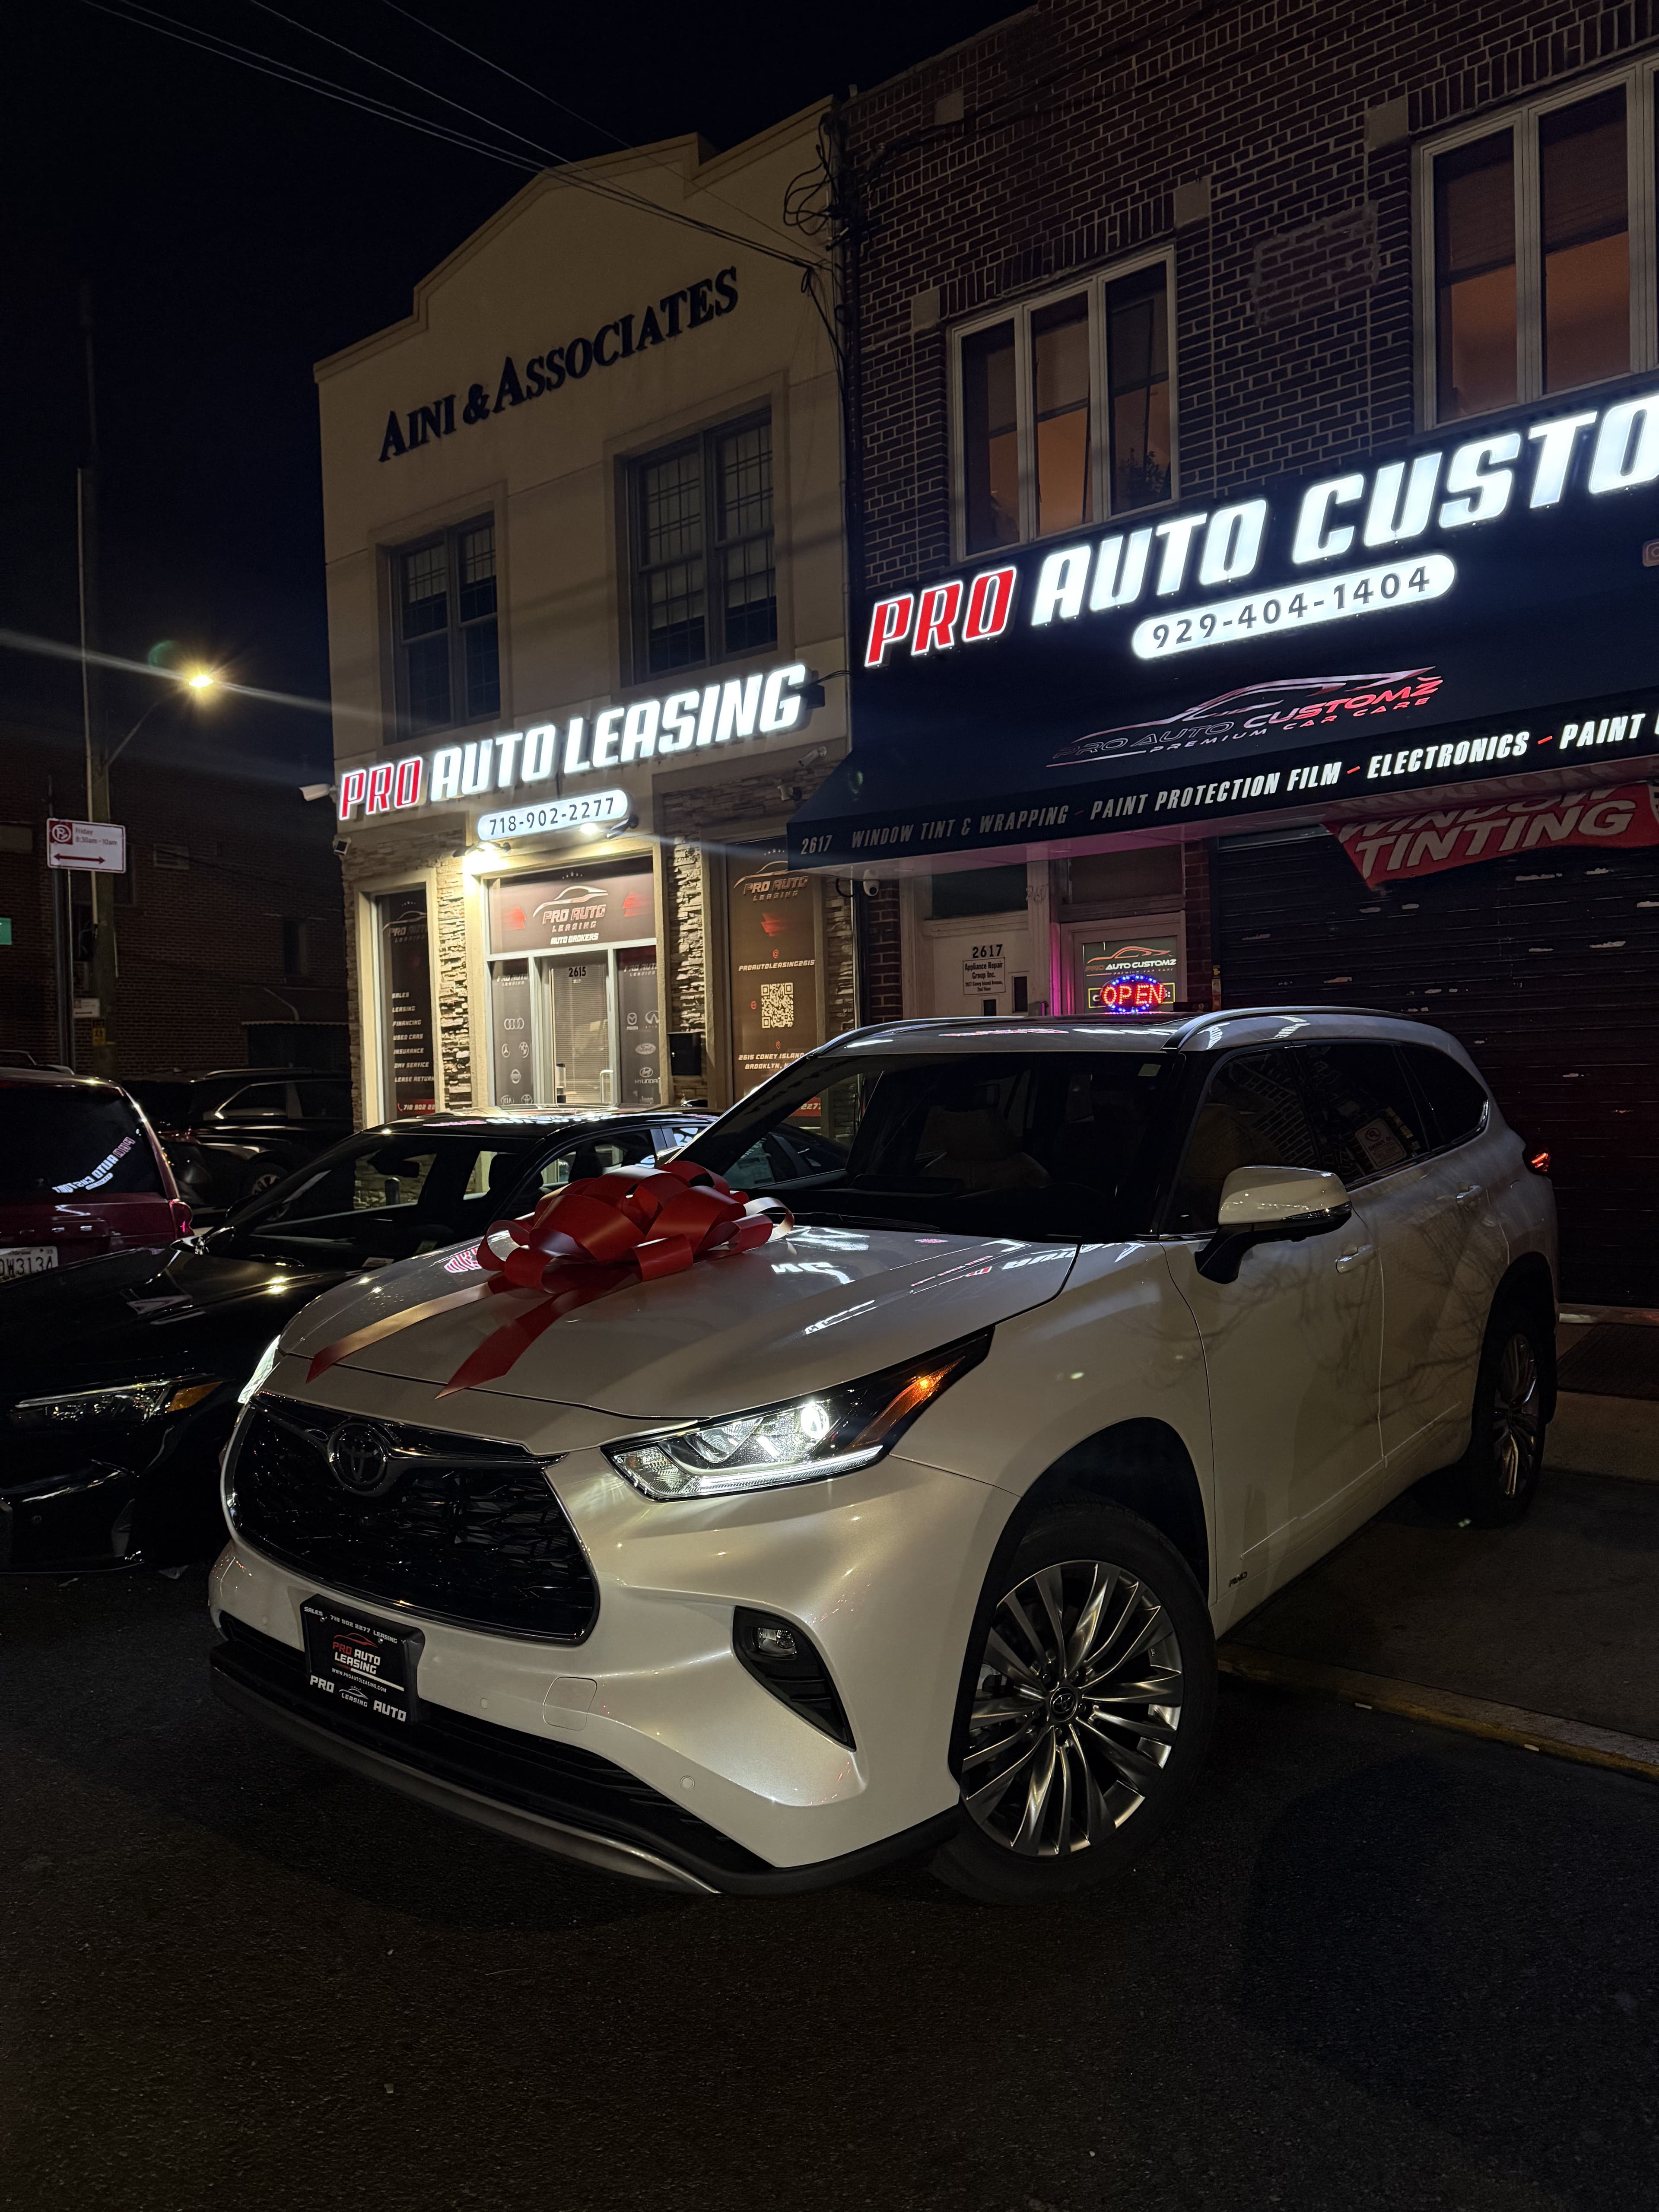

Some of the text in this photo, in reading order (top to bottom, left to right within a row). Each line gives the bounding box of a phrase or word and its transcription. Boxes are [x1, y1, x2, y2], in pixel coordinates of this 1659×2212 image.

[378, 266, 738, 462] AINI & ASSOCIATES
[864, 394, 1659, 667] PRO AUTO CUSTO
[1152, 566, 1431, 649] 929-404-1404
[1053, 677, 1443, 760] PRO AUTO CUSTOMZ
[1150, 697, 1430, 753] PREMIUM CAR CARE
[339, 663, 807, 820] PRO AUTO LEASING
[800, 834, 833, 855] 2617
[851, 823, 915, 849] WINDOW
[920, 818, 956, 841] TINT
[960, 818, 972, 837] &
[979, 804, 1069, 833] WRAPPING
[1090, 793, 1149, 820] PAINT
[1154, 775, 1280, 811] PROTECTION
[1286, 761, 1343, 793] FILM
[1367, 731, 1531, 779] ELECTRONICS
[1559, 712, 1646, 750] PAINT
[489, 797, 615, 836] 718-902-2277
[1354, 799, 1637, 880] TINTING
[744, 876, 809, 894] PRO AUTO
[753, 890, 798, 901] LEASING
[542, 904, 607, 924] PRO AUTO
[552, 921, 597, 933] LEASING
[550, 932, 599, 945] AUTO BROKERS
[973, 944, 1003, 958] 2617
[569, 966, 586, 977] 2615
[738, 960, 815, 971] PROAUTOLEASING2615
[965, 961, 1003, 971] Appliance Repair
[1132, 959, 1177, 968] CUSTOMZ
[1102, 983, 1165, 1005] OPEN
[304, 1606, 323, 1616] SALES
[341, 1619, 353, 1628] 902
[355, 1624, 370, 1633] 2277
[373, 1630, 397, 1644] LEASING
[332, 1641, 381, 1665] PRO AUTO
[334, 1652, 377, 1675] LEASING
[310, 1675, 335, 1693] PRO
[331, 1668, 387, 1693] WWW.PROAUTOLEASING.COM
[341, 1692, 368, 1707] LEASING
[373, 1700, 407, 1722] AUTO
